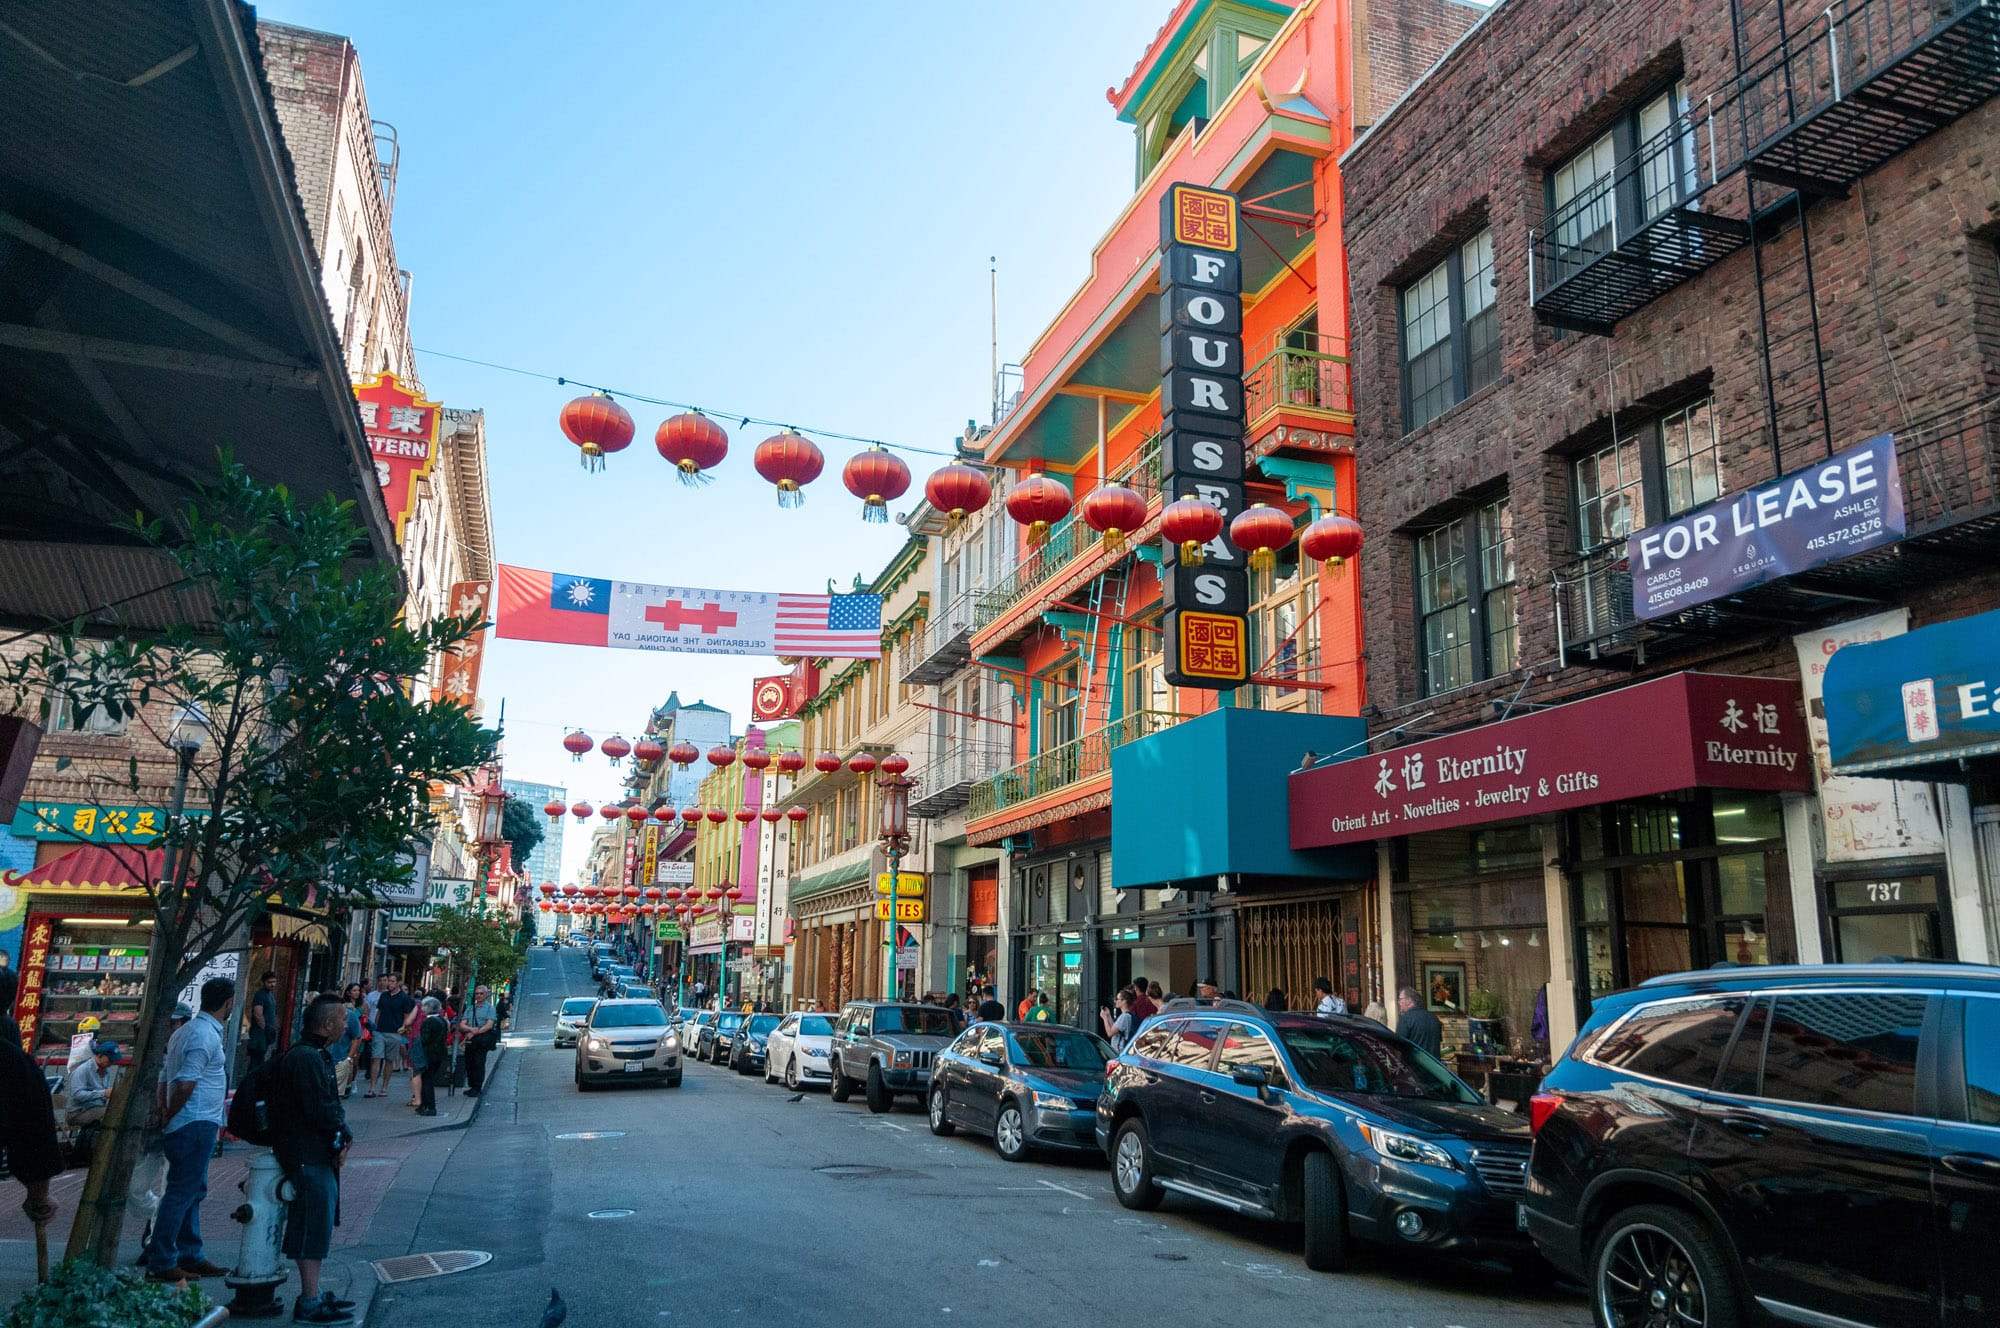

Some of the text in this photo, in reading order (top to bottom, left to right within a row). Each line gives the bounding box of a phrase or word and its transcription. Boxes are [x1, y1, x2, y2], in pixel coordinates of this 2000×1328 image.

[1188, 254, 1234, 605] FOUR SEAS
[1640, 450, 1877, 570] FOR LEASE
[1834, 496, 1878, 520] ASHLEY
[1807, 517, 1882, 550] 415.572.6376
[1646, 568, 1681, 587] CARLOS
[1732, 555, 1777, 575] SEQUOIA
[1648, 577, 1709, 604] 415.608.8409
[1438, 745, 1528, 784] Eternity
[1705, 741, 1798, 772] Eternity
[1332, 771, 1599, 833] Orient Art Novelties Jewelry & Gifts
[764, 833, 770, 852] of
[773, 832, 787, 916] 國銀行
[881, 877, 922, 891] CHA TOWN
[760, 865, 769, 940] America
[1867, 882, 1901, 902] 737
[883, 904, 919, 916] KTES
